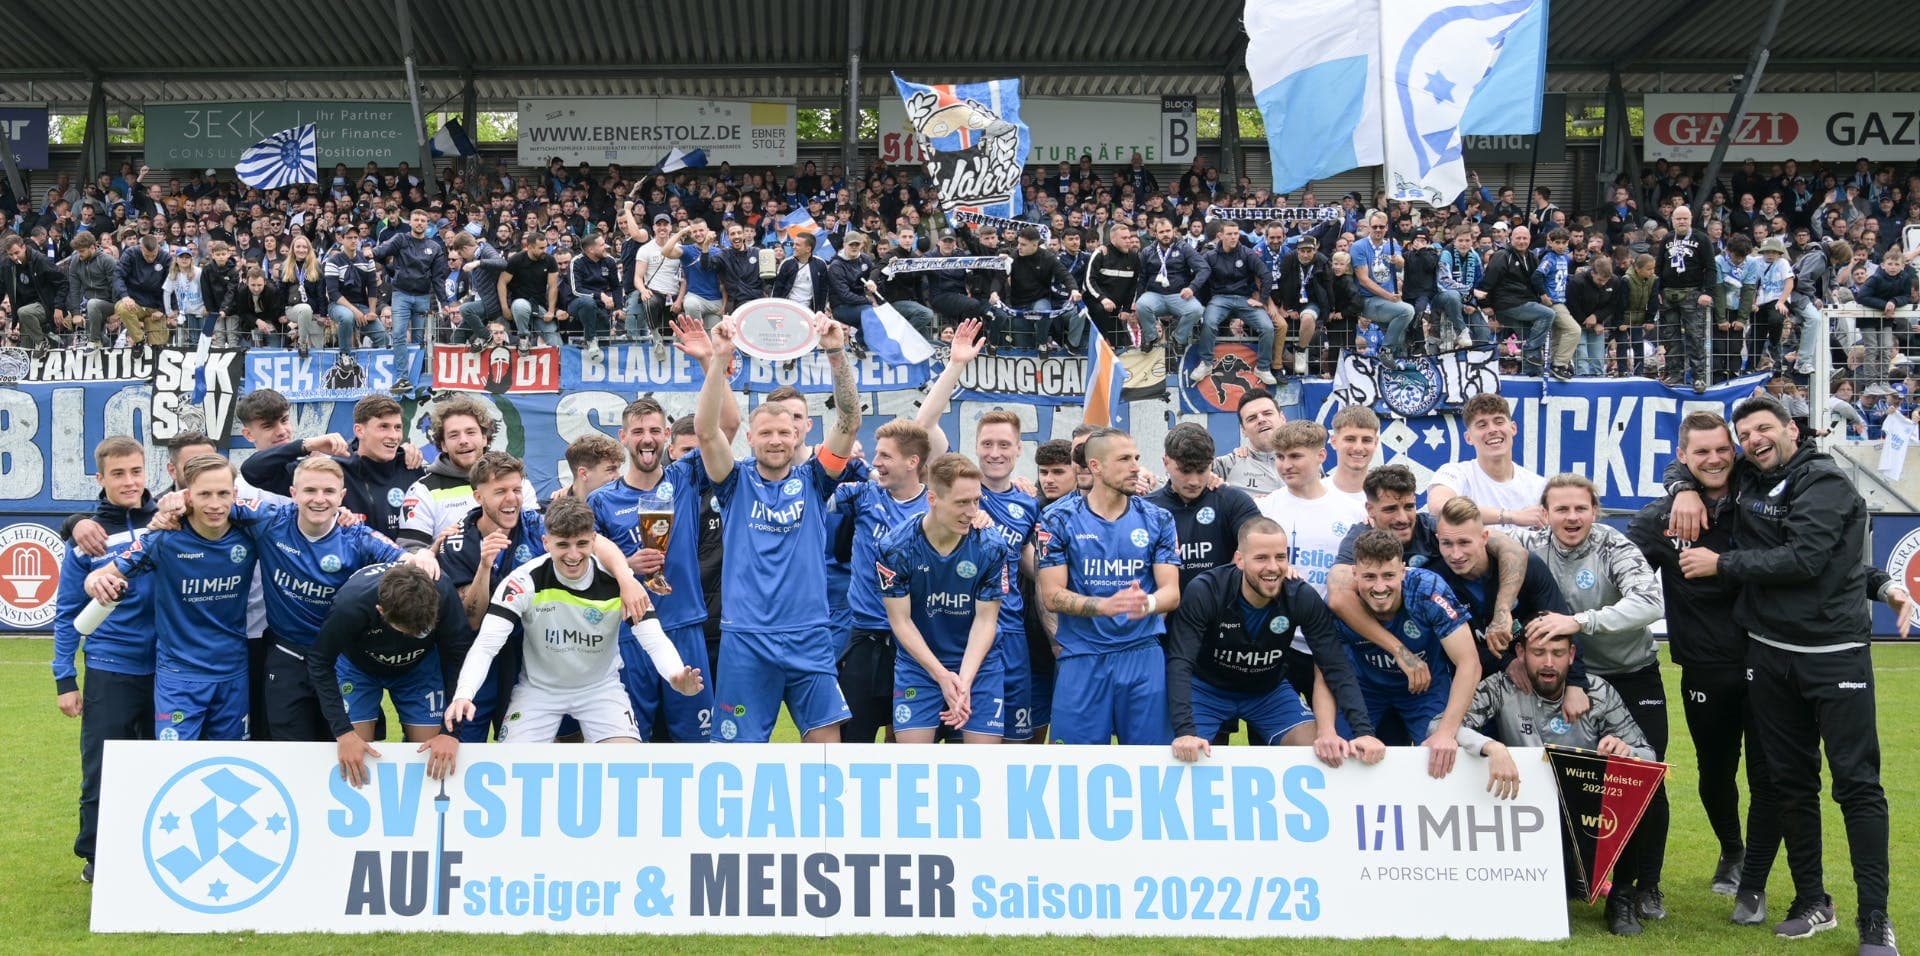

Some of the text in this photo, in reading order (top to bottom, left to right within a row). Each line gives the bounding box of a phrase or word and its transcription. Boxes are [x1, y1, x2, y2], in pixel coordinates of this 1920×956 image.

[1164, 100, 1194, 109] BLOCK
[316, 110, 393, 121] Ihr Partner
[341, 128, 402, 139] Finance-
[529, 125, 741, 142] WWW.EBNERSTOLZ.DE
[751, 129, 785, 138] EBNER
[1170, 118, 1190, 156] B
[317, 147, 392, 158] Positionen
[752, 140, 785, 149] STOLZ
[1034, 142, 1155, 161] TURSÄFTE
[169, 149, 247, 160] CONSUL
[1212, 207, 1320, 220] STUTTGART
[29, 347, 152, 380] FANATIC
[155, 349, 237, 393] SEK
[438, 352, 485, 384] UR
[581, 343, 693, 383] BLAUE
[254, 356, 314, 391] SEK
[957, 357, 1036, 394] OUNG
[1246, 478, 1259, 488] JL
[708, 518, 721, 530] 21
[1104, 559, 1145, 577] MHP
[202, 575, 242, 593] MHP
[292, 578, 336, 599] MHP
[932, 592, 971, 608] MHP
[563, 629, 604, 647] MHP
[378, 648, 425, 665] MHP
[1236, 649, 1283, 666] MHP
[425, 690, 444, 712] 17
[1689, 689, 1707, 703] YD
[993, 698, 1003, 719] 7
[1565, 766, 1644, 787] Württ. Meister
[1582, 782, 1624, 798] 2022/23
[327, 761, 1330, 843] SV STUTTGARTER KICKERS
[1417, 804, 1545, 852] MHP
[1581, 811, 1614, 831] wfv
[1360, 865, 1549, 882] A PORSCHE COMPANY
[633, 865, 675, 918] &
[689, 852, 956, 919] MEISTER
[971, 874, 1121, 920] Saison
[1134, 875, 1321, 922] 2022/23
